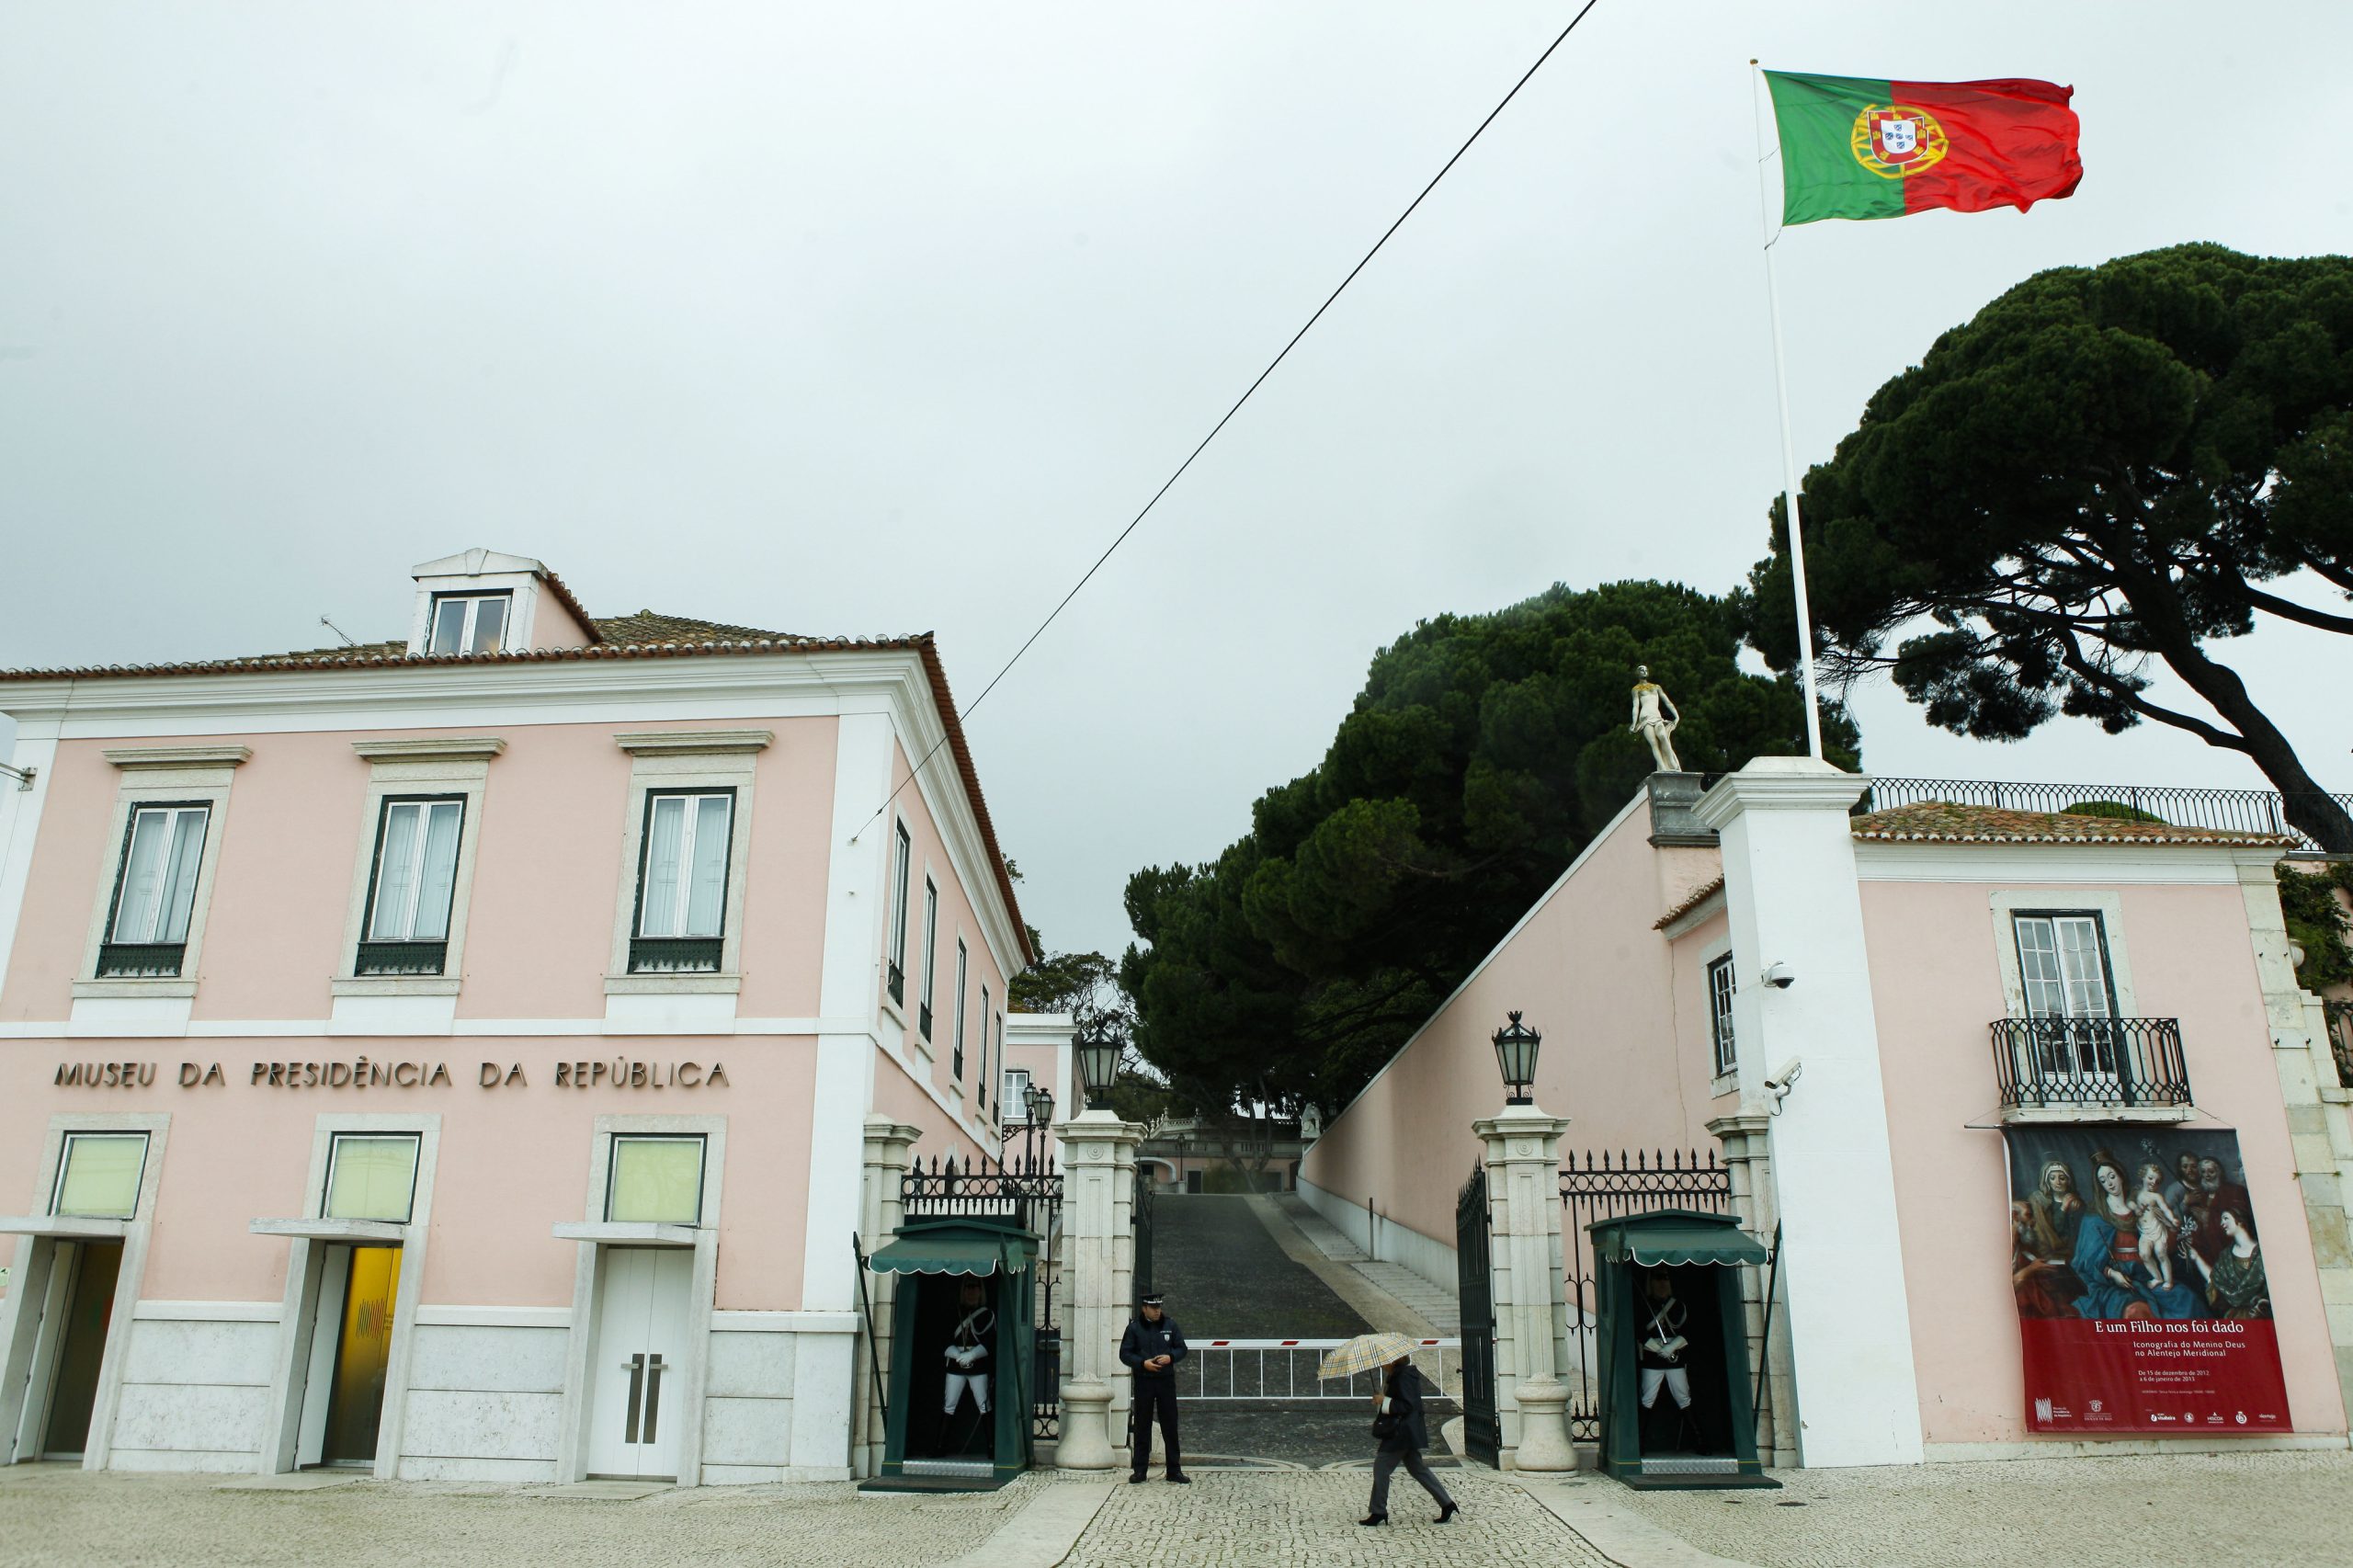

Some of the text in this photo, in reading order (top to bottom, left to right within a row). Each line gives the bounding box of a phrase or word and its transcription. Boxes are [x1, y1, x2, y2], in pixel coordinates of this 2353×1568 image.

[53, 1054, 730, 1088] MUSEU DA PRESIDÊNCIA DA REPÚBLICA
[2095, 1321, 2244, 1333] E um Filho nos foi dado
[2133, 1341, 2178, 1349] Iconografia
[2147, 1349, 2181, 1358] Alentejo
